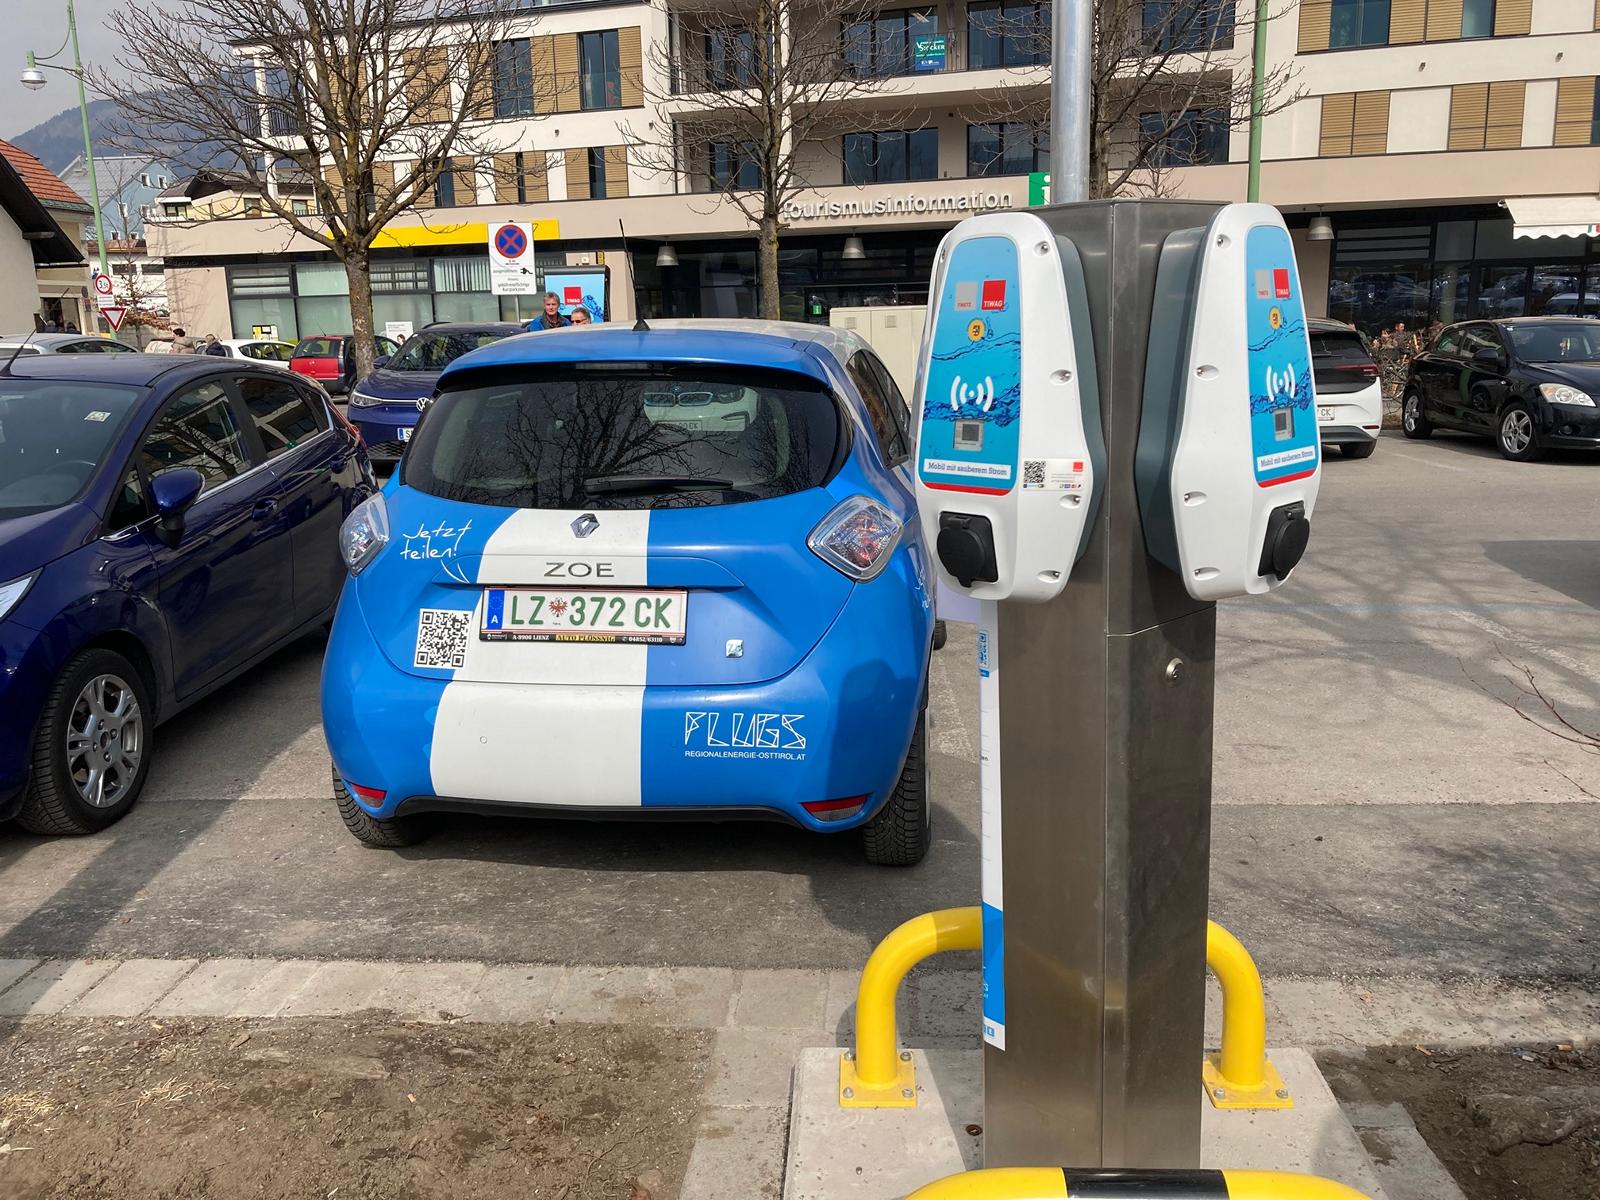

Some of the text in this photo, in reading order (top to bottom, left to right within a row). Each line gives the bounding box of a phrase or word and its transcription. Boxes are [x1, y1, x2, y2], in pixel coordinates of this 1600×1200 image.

[983, 300, 1003, 308] TIWAG
[928, 462, 945, 470] Mobil
[957, 465, 988, 474] sauberem
[988, 467, 1007, 475] Strom
[402, 519, 472, 539] Jetzt
[543, 562, 615, 579] ZOE
[490, 595, 672, 629] A LZ 372 CK
[557, 634, 577, 642] AUTO
[685, 711, 807, 749] FLUGS
[685, 750, 806, 761] REGIONALENERGIE-OSTTIROL.AT
